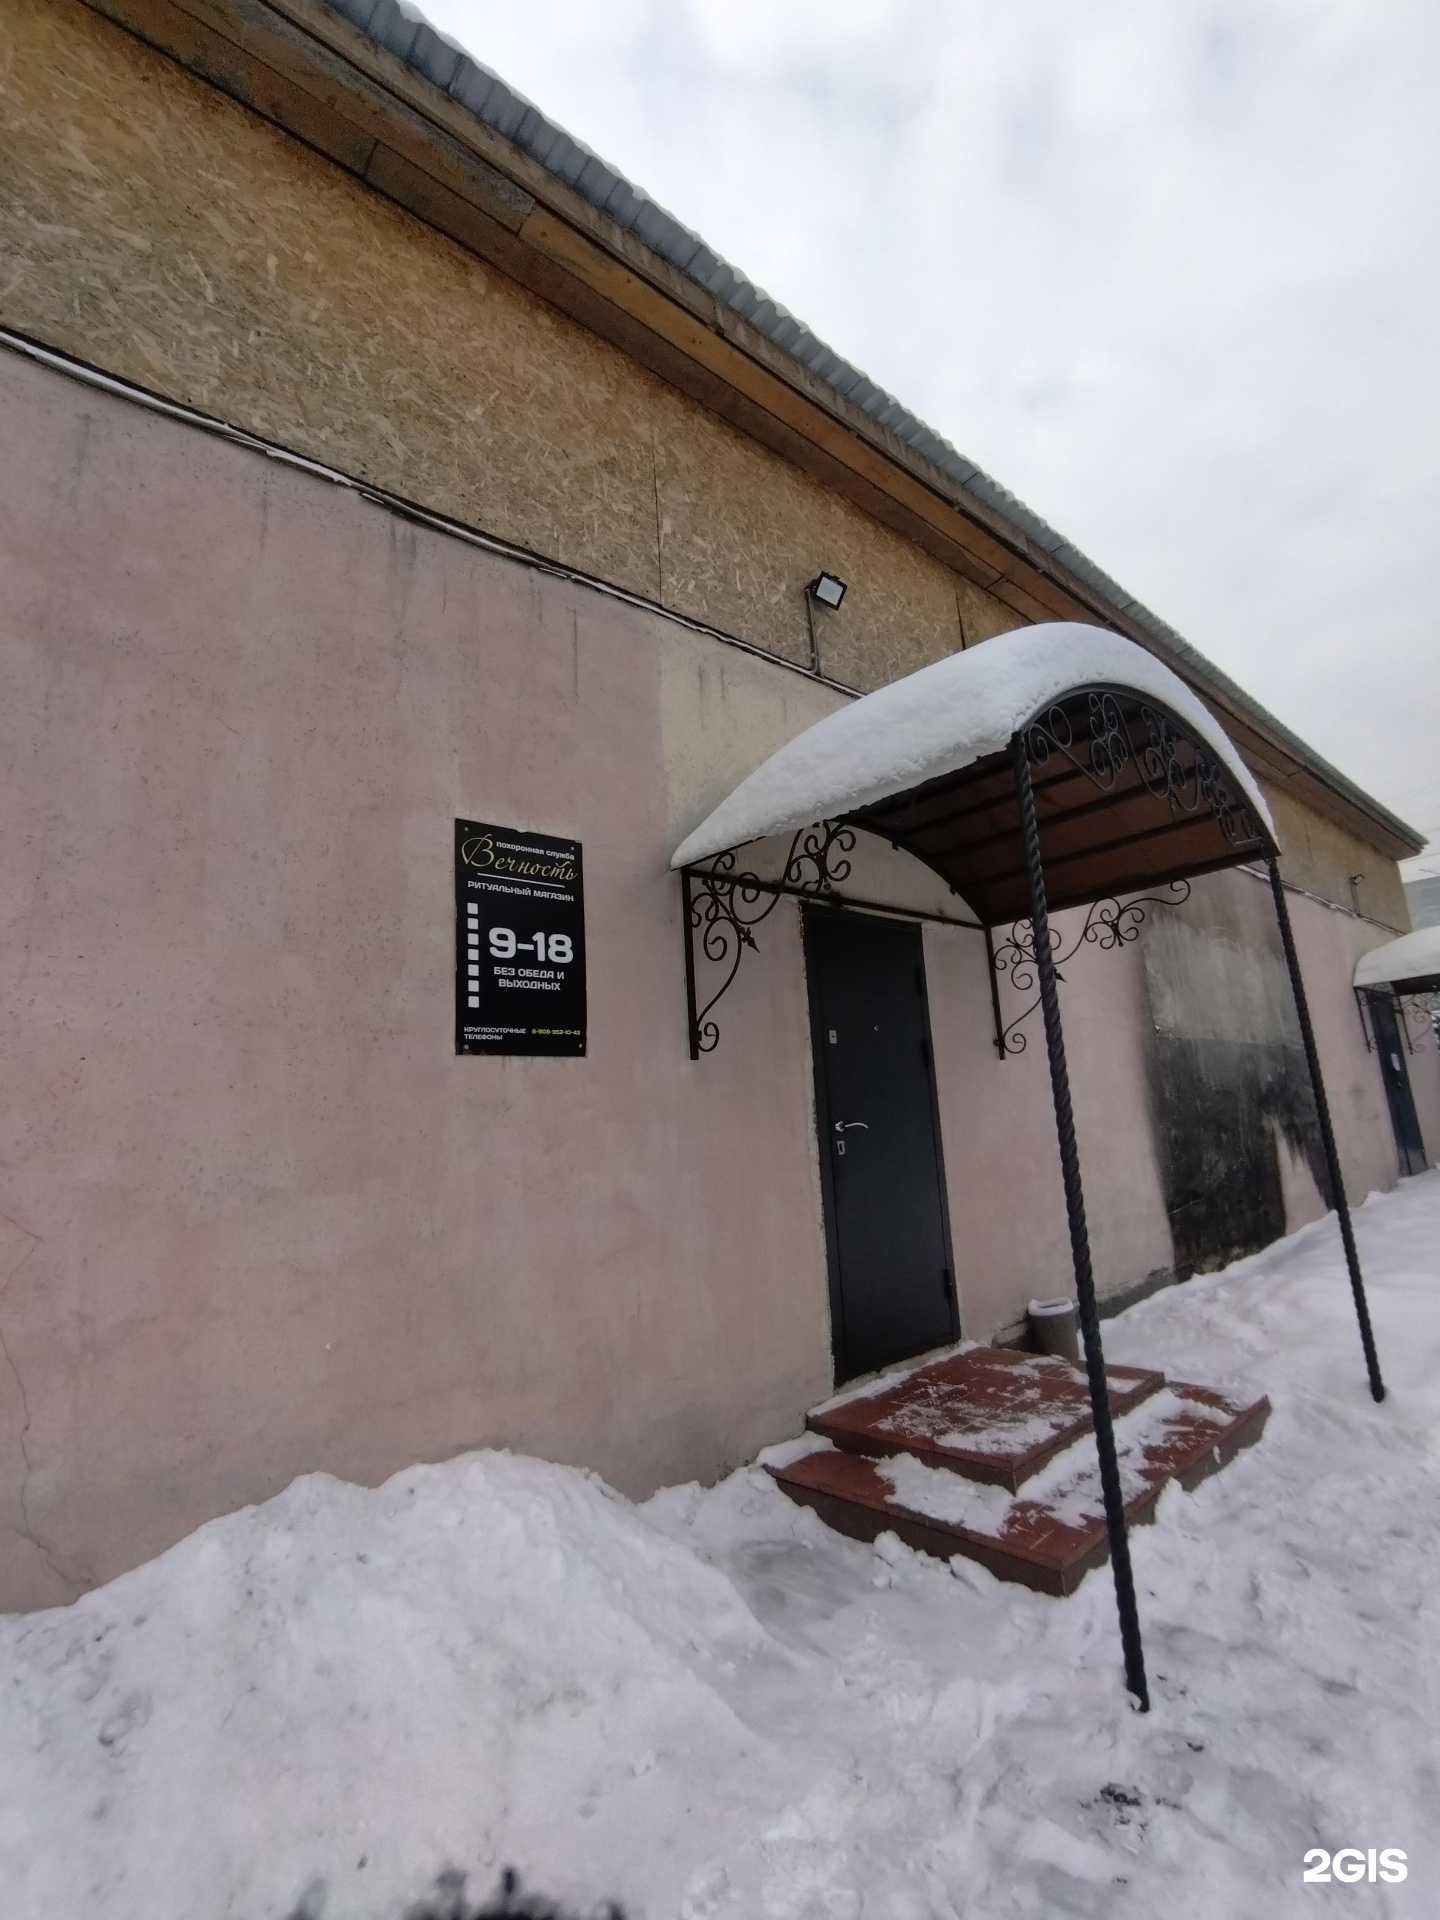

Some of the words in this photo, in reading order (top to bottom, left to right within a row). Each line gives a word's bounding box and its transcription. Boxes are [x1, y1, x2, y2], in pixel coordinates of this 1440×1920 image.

[461, 833, 578, 880] Вечность
[496, 841, 545, 855] похоронная
[545, 850, 575, 860] служба
[467, 880, 532, 896] РИТУАЛЬНЫЙ
[533, 890, 575, 901] МАГАЗИН
[488, 927, 574, 963] 9-18
[493, 966, 515, 976] БЕЗ
[517, 968, 554, 979] ОБЕДА
[556, 971, 565, 980] И
[498, 978, 561, 991] ВЫХОДНЫХ
